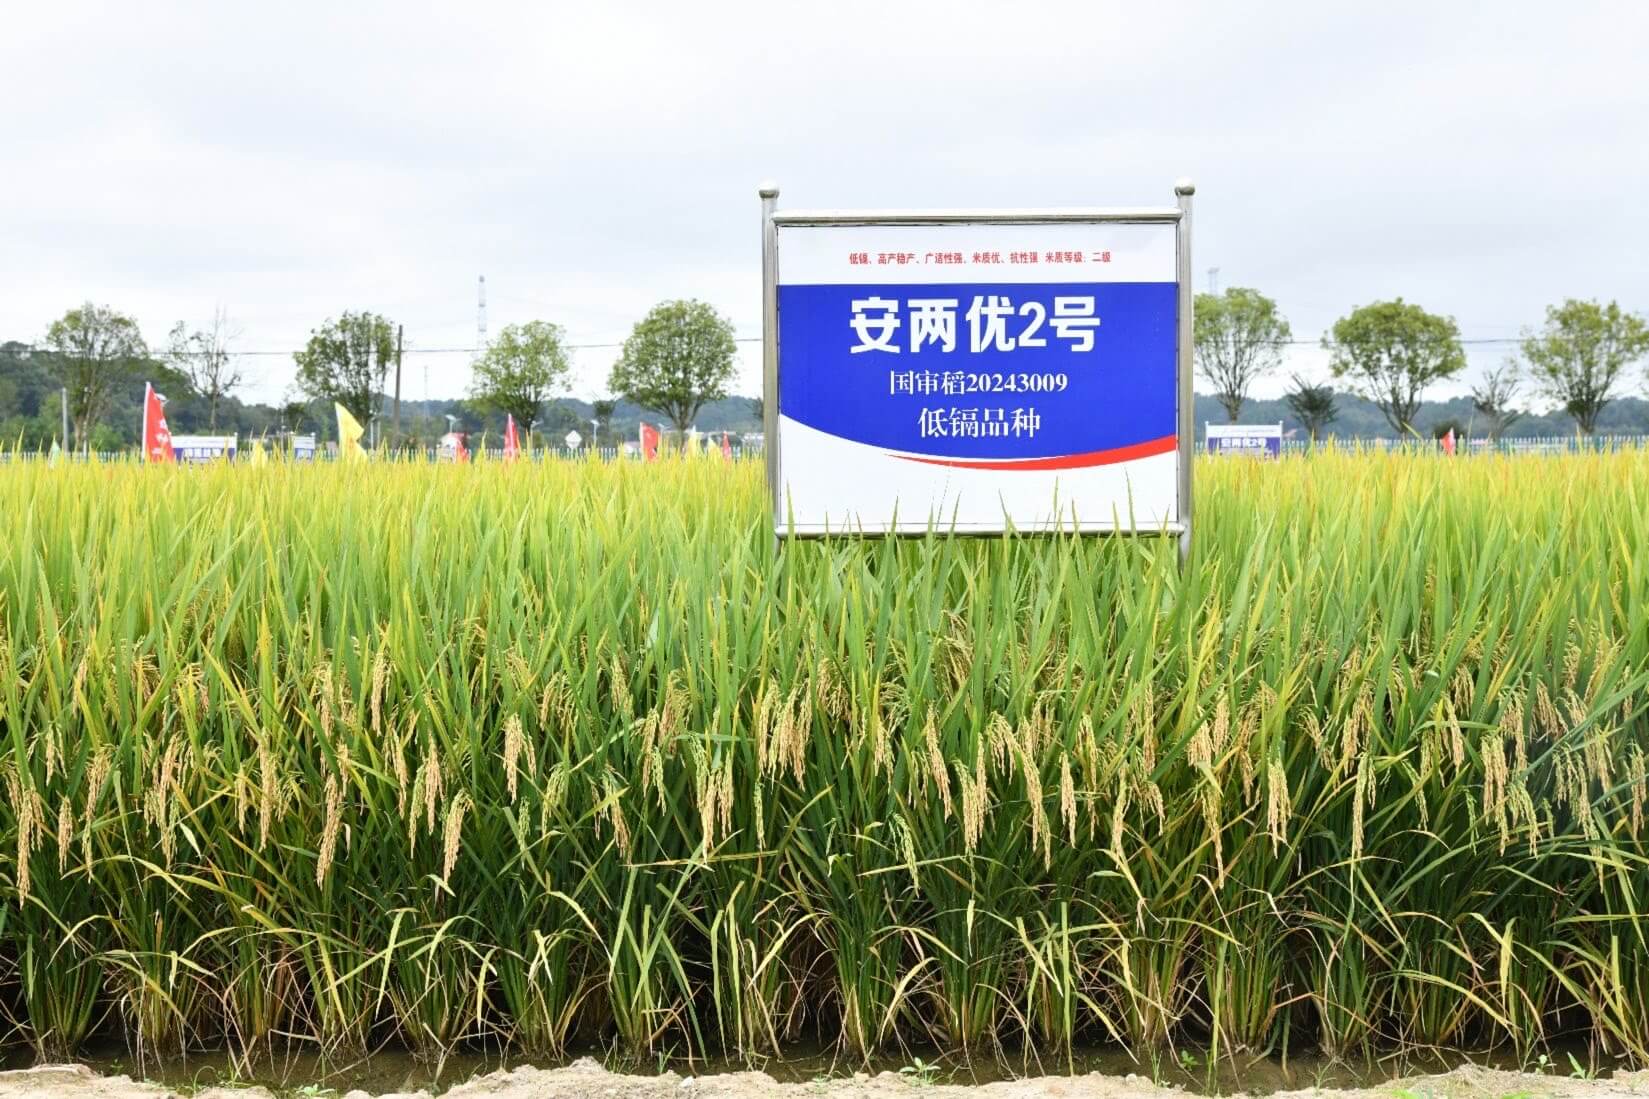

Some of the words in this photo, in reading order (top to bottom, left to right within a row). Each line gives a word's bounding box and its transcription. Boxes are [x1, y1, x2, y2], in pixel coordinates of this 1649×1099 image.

[850, 296, 1100, 354] 安两优2号
[890, 369, 1068, 395] 国审稻20243009
[918, 407, 1041, 438] 低镉品种
